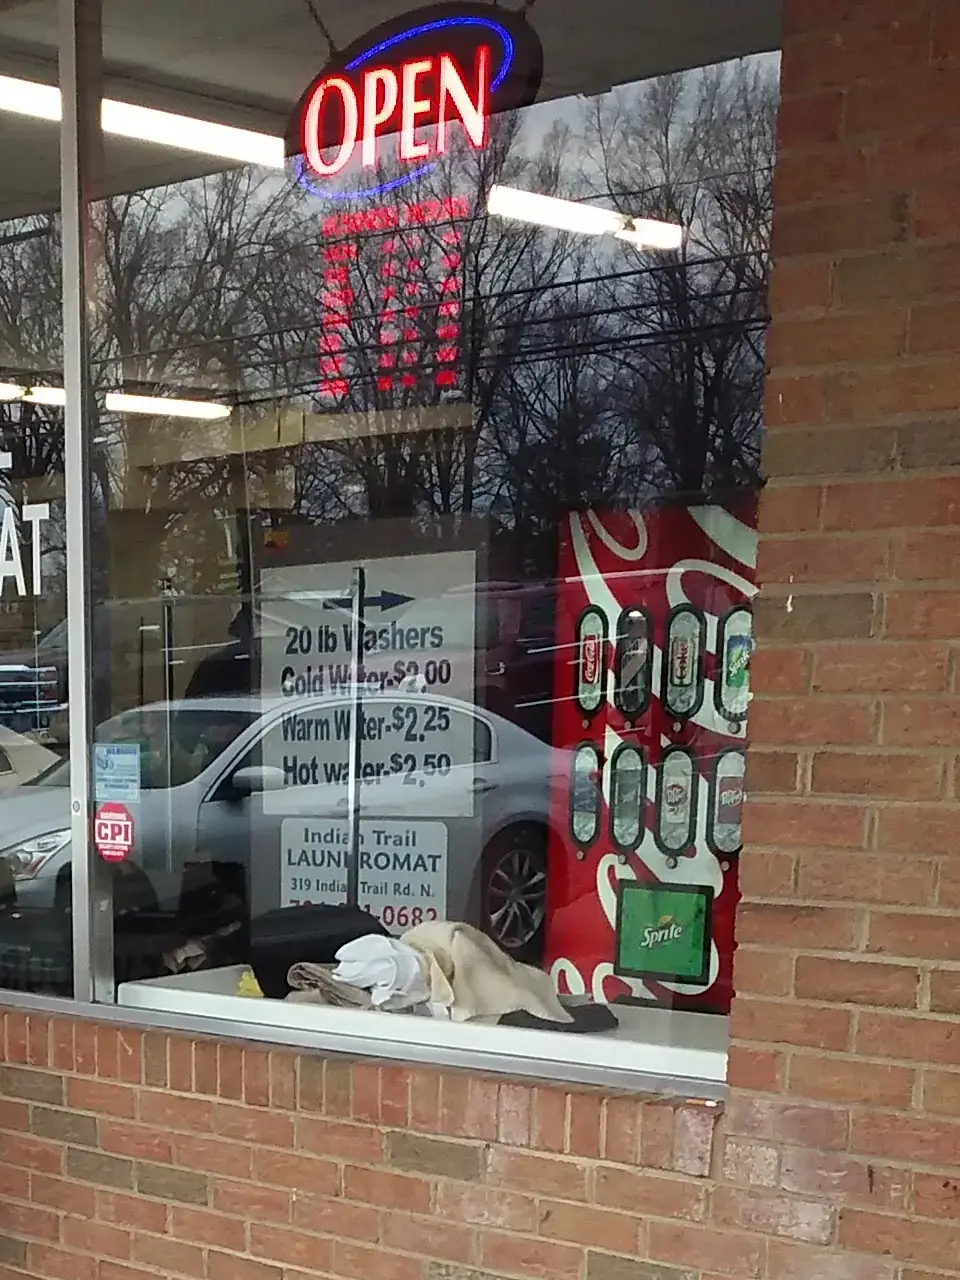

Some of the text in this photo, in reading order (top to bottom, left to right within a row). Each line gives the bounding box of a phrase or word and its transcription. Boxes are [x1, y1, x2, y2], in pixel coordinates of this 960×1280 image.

[304, 45, 489, 176] OPEN
[285, 626, 312, 655] 20
[318, 625, 338, 653] lb
[281, 665, 324, 698] Cold
[282, 705, 451, 742] Warm Wter-$2.25
[283, 752, 452, 788] Hot waer-$2.50
[97, 822, 130, 842] CPI
[372, 829, 417, 847] Trail
[291, 878, 436, 898] 319 India Trail Rd. N.
[640, 923, 683, 949] Sprite
